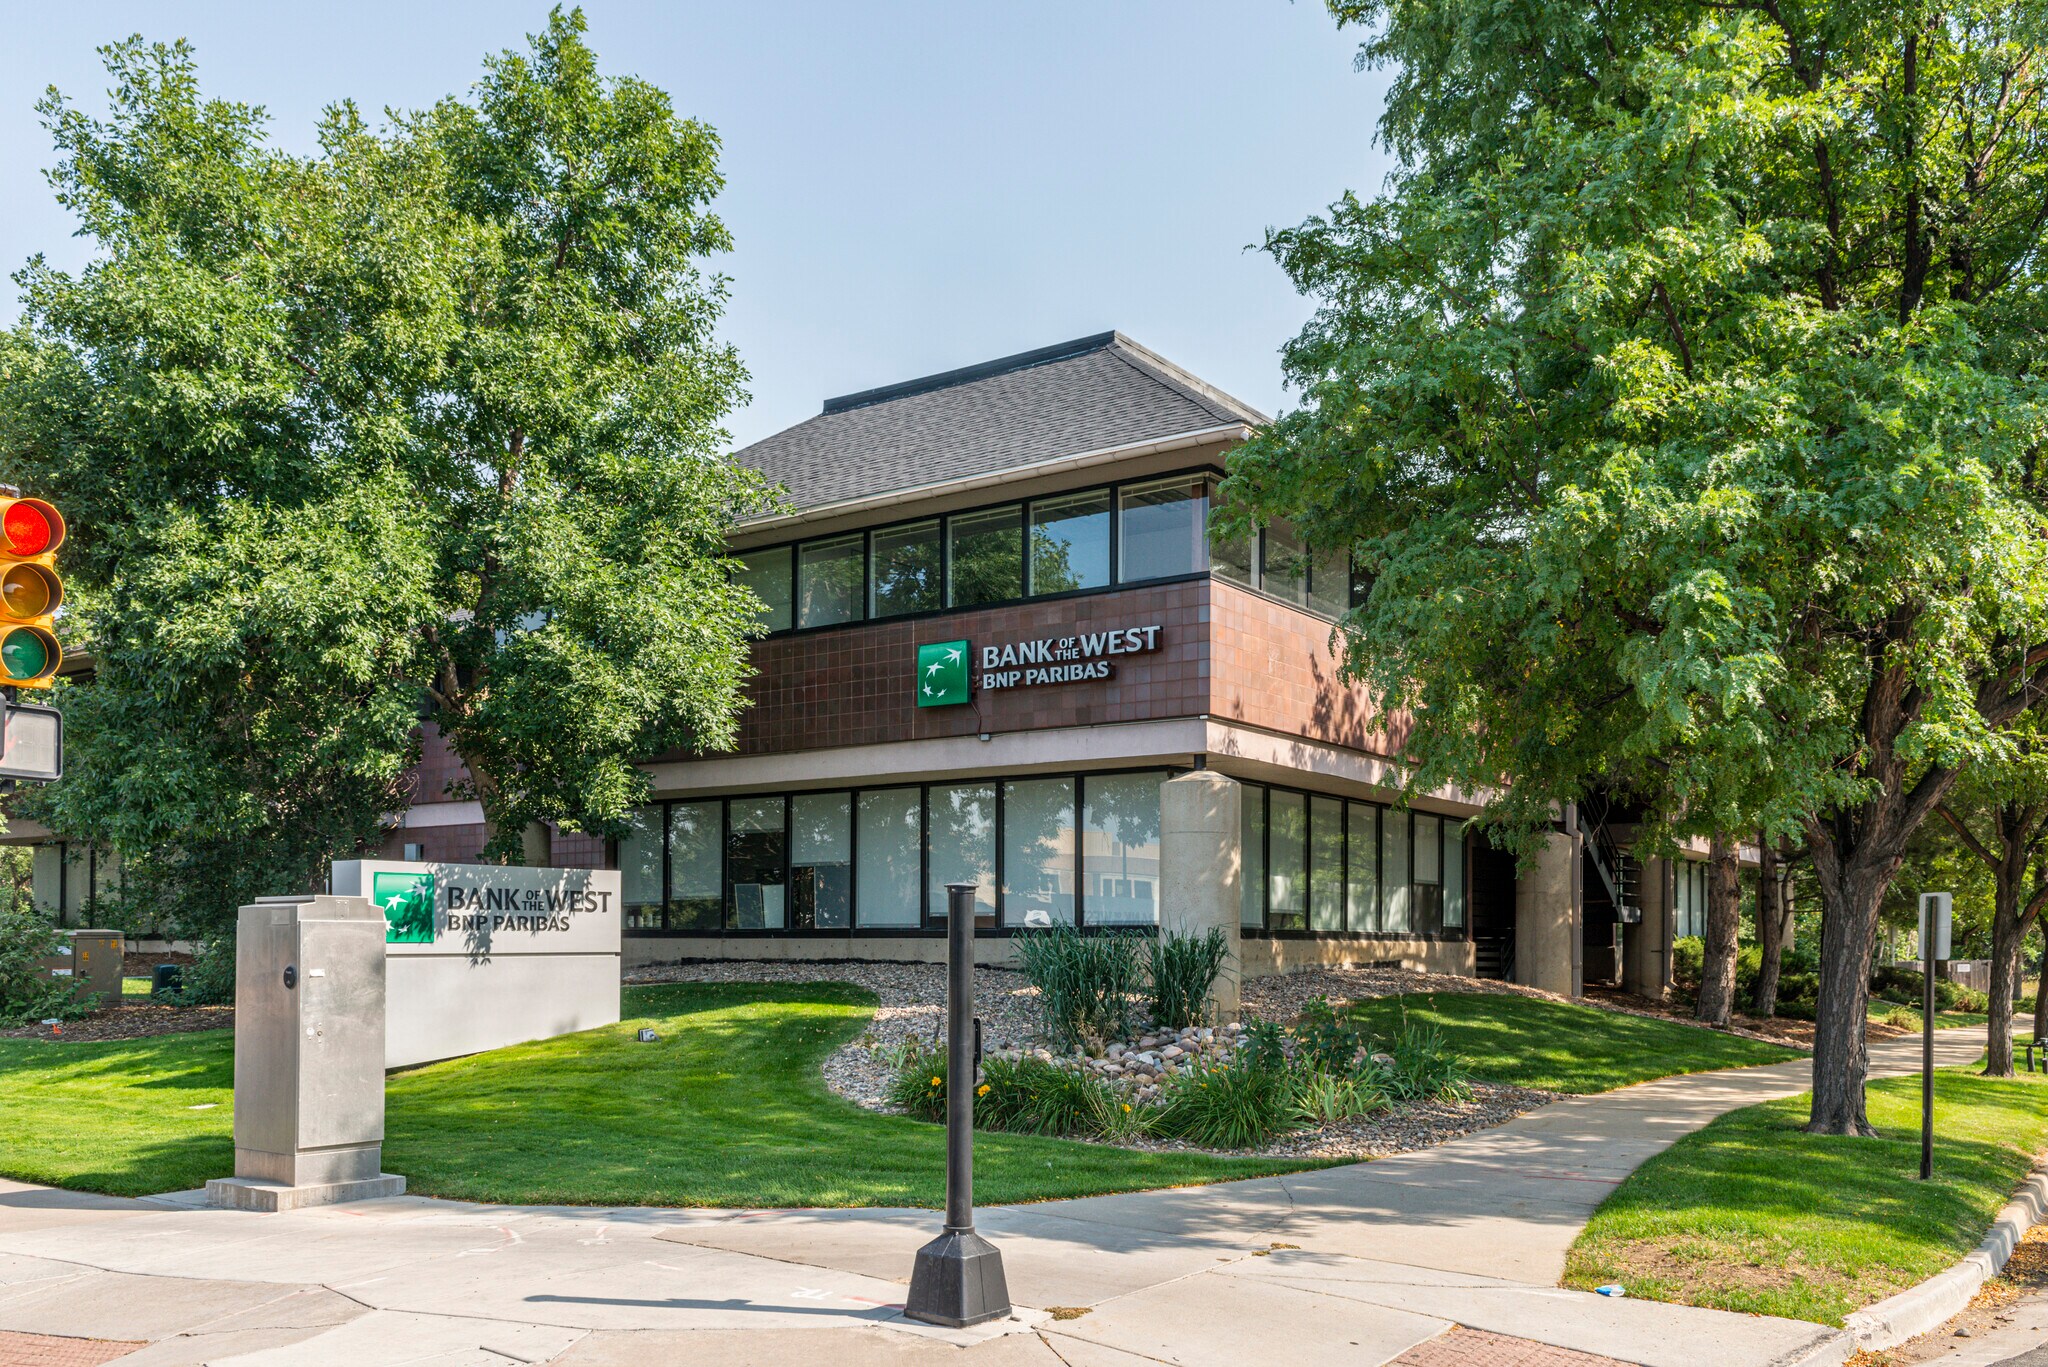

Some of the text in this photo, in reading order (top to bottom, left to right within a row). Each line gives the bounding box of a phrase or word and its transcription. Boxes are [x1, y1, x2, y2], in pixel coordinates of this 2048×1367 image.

[983, 625, 1161, 669] BANK OF THE WEST
[983, 661, 1109, 690] BNP PARIBAS
[447, 887, 612, 914] BANK OF THE WEST
[447, 915, 570, 932] BNP PARIBAS
